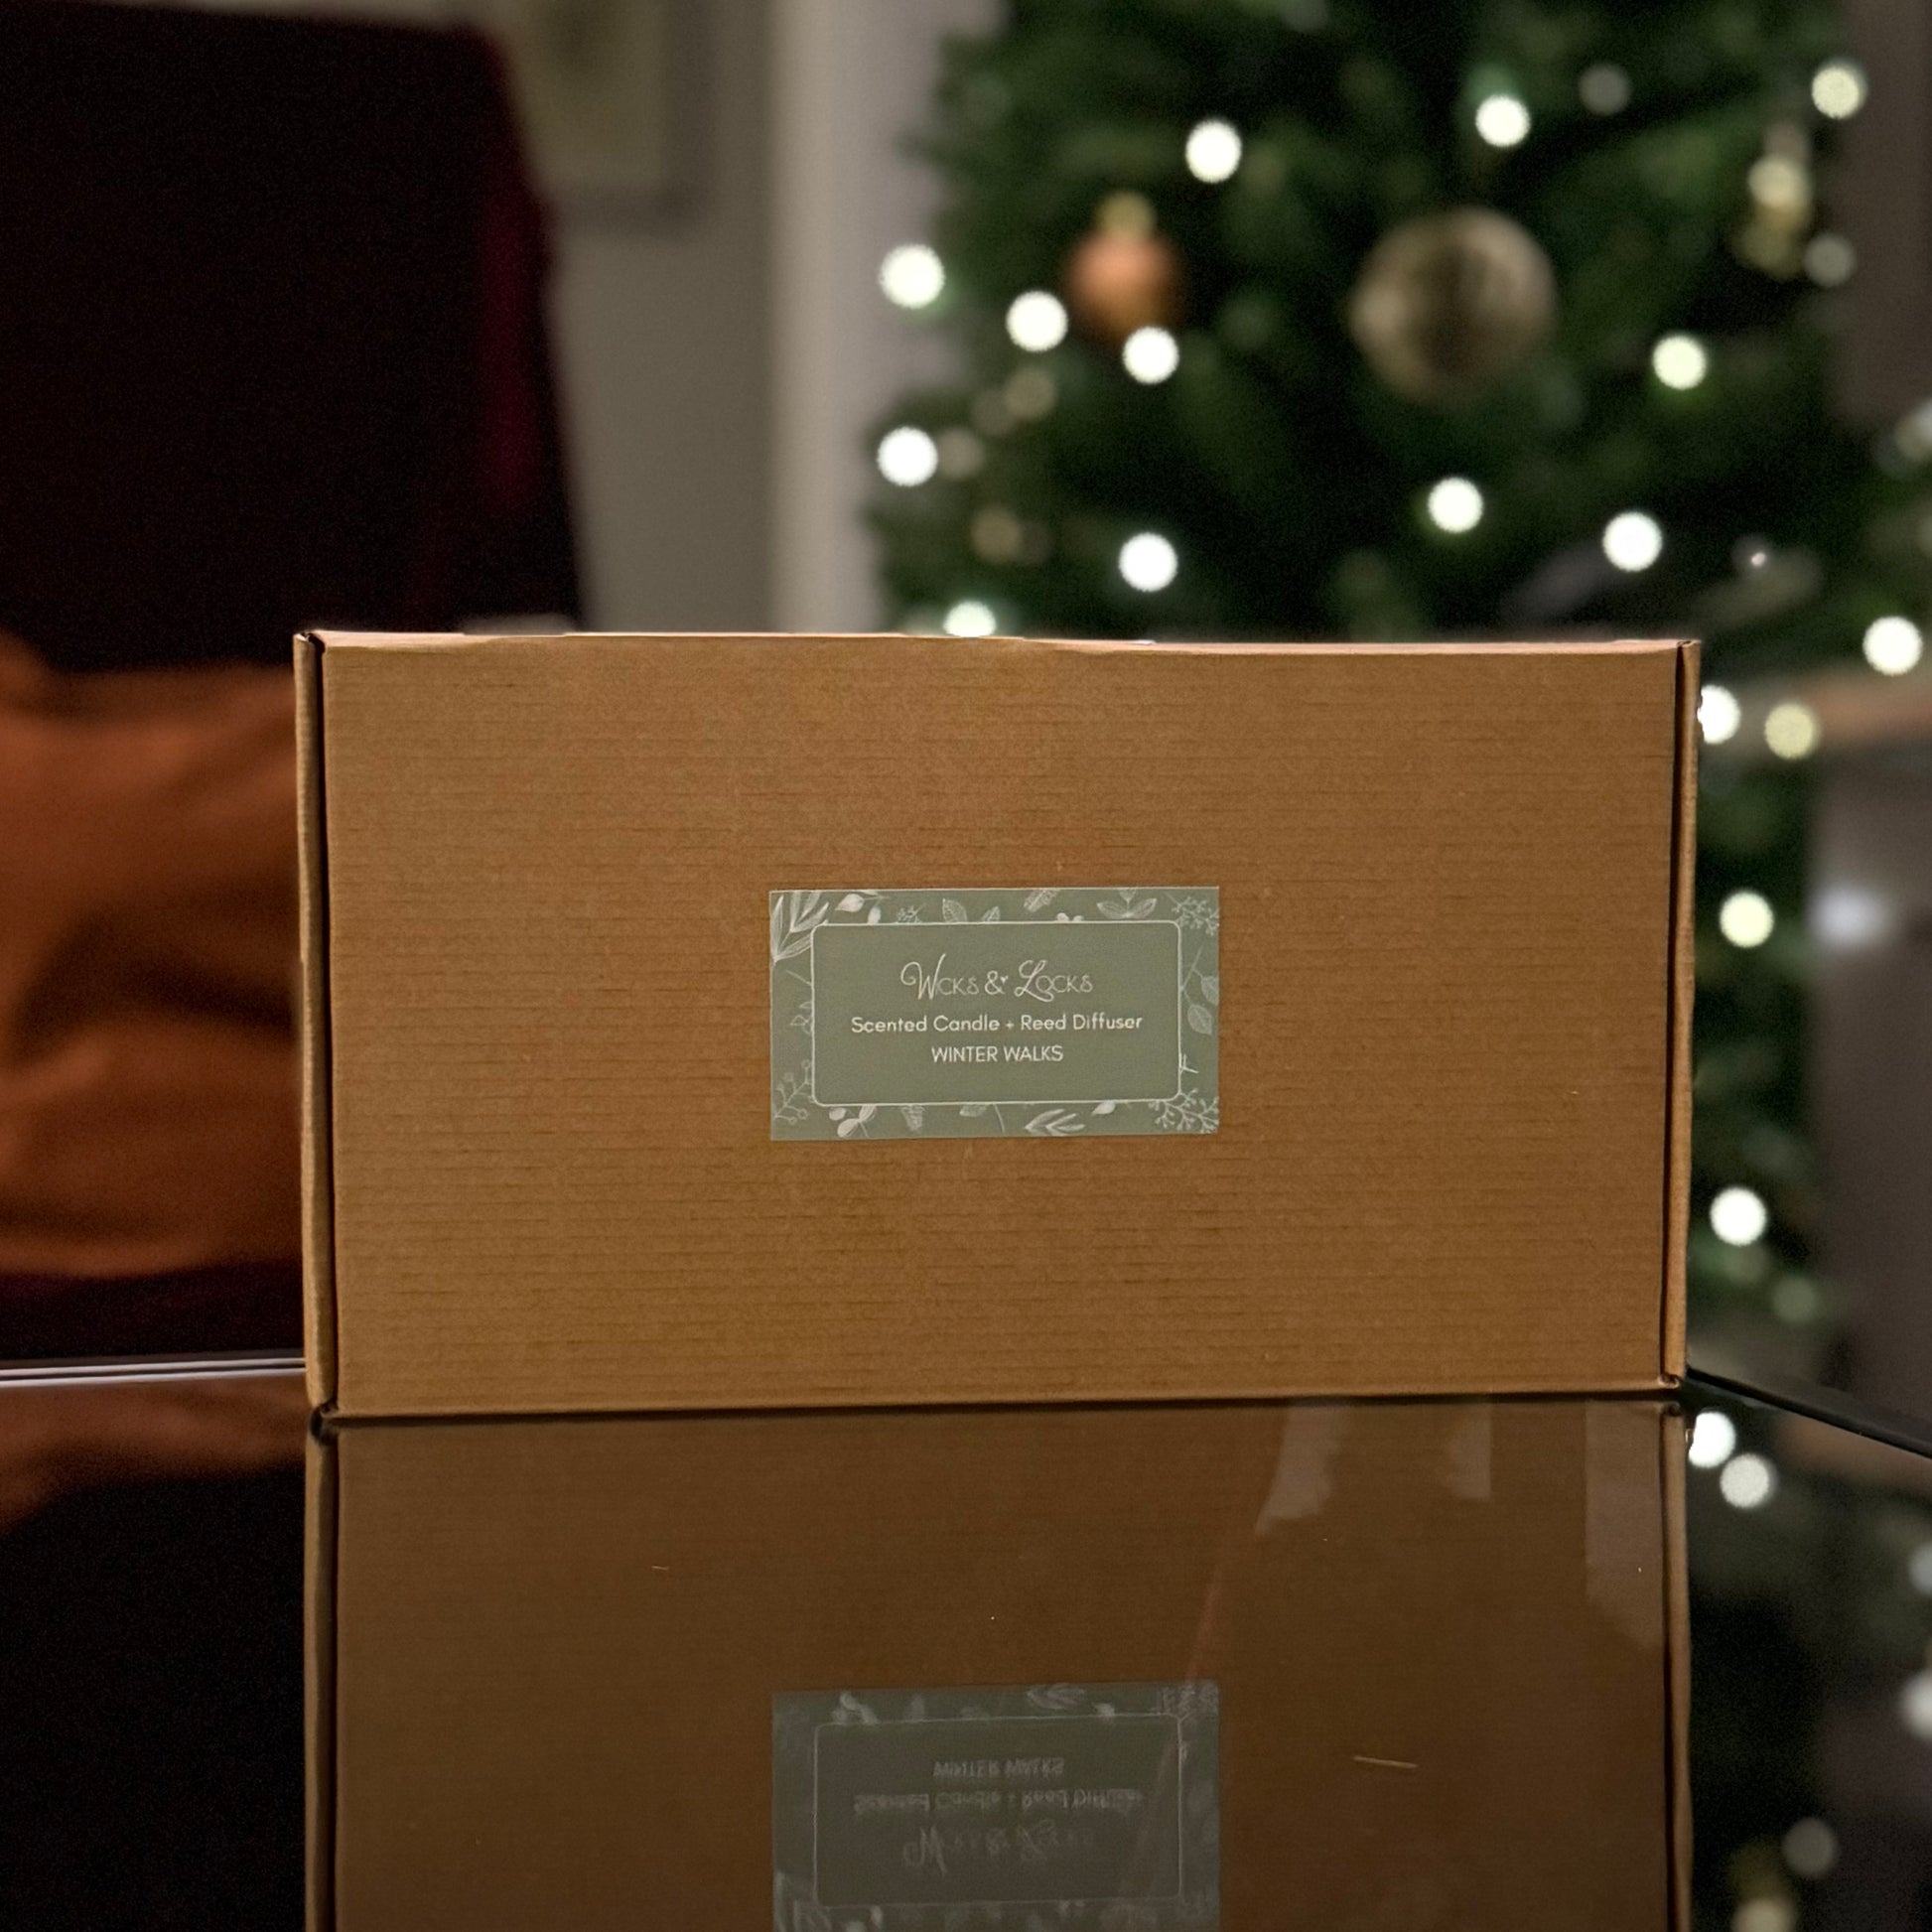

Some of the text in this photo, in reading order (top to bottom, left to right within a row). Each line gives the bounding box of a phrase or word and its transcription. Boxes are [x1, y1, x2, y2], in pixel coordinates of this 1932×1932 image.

[984, 970, 1009, 995] &
[851, 1015, 927, 1034] Scented
[933, 1014, 1000, 1032] Candle
[1020, 1013, 1066, 1031] Reed
[1072, 1012, 1143, 1030] Diffuser
[931, 1044, 1063, 1062] WINTER WALKS
